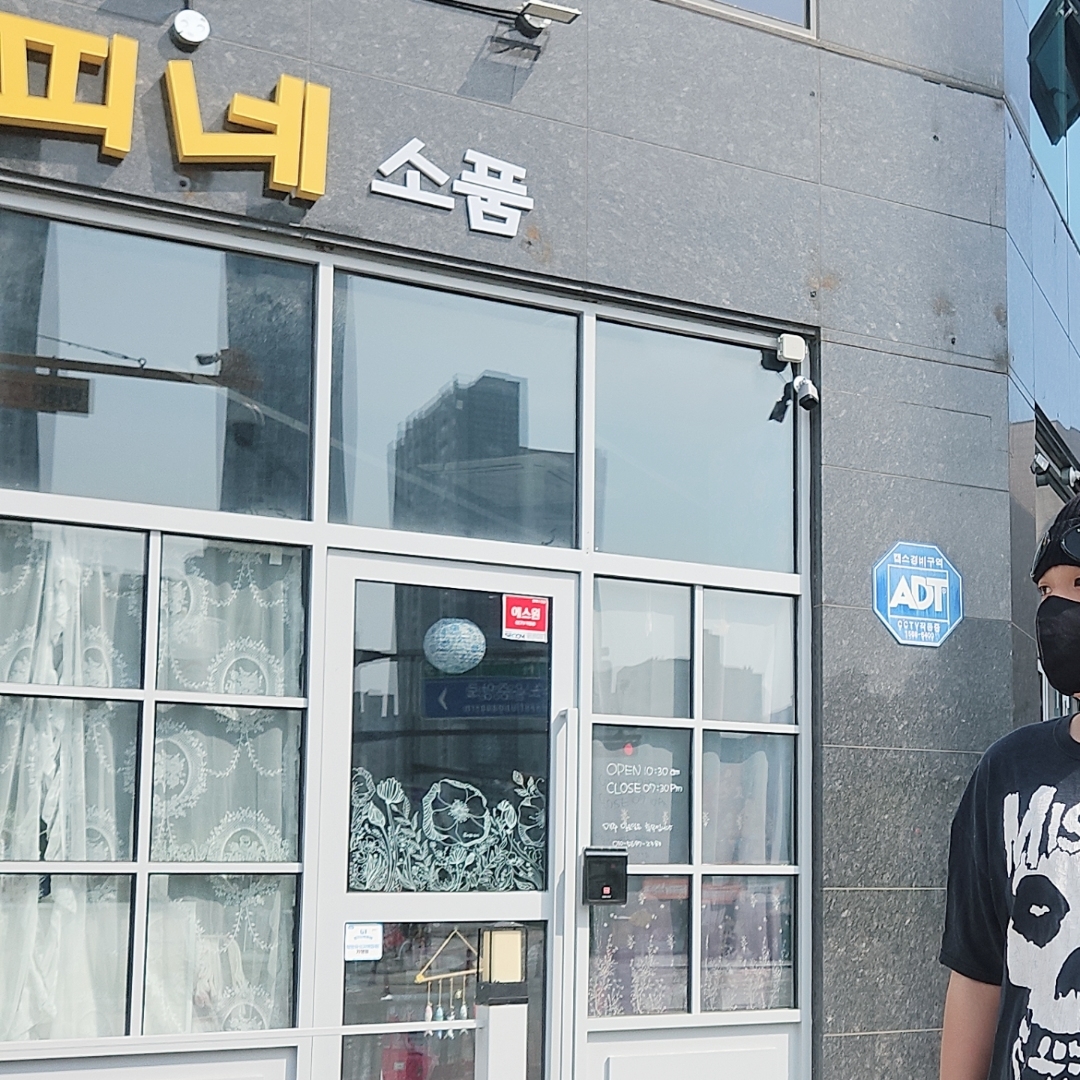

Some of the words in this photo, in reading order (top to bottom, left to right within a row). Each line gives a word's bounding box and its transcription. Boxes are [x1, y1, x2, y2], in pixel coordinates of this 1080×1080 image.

[371, 137, 534, 238] 소품
[890, 575, 948, 612] ADT
[510, 605, 542, 621] 에스원
[606, 763, 641, 776] OPEN
[644, 766, 669, 777] 10:30
[606, 781, 642, 795] CLOSE
